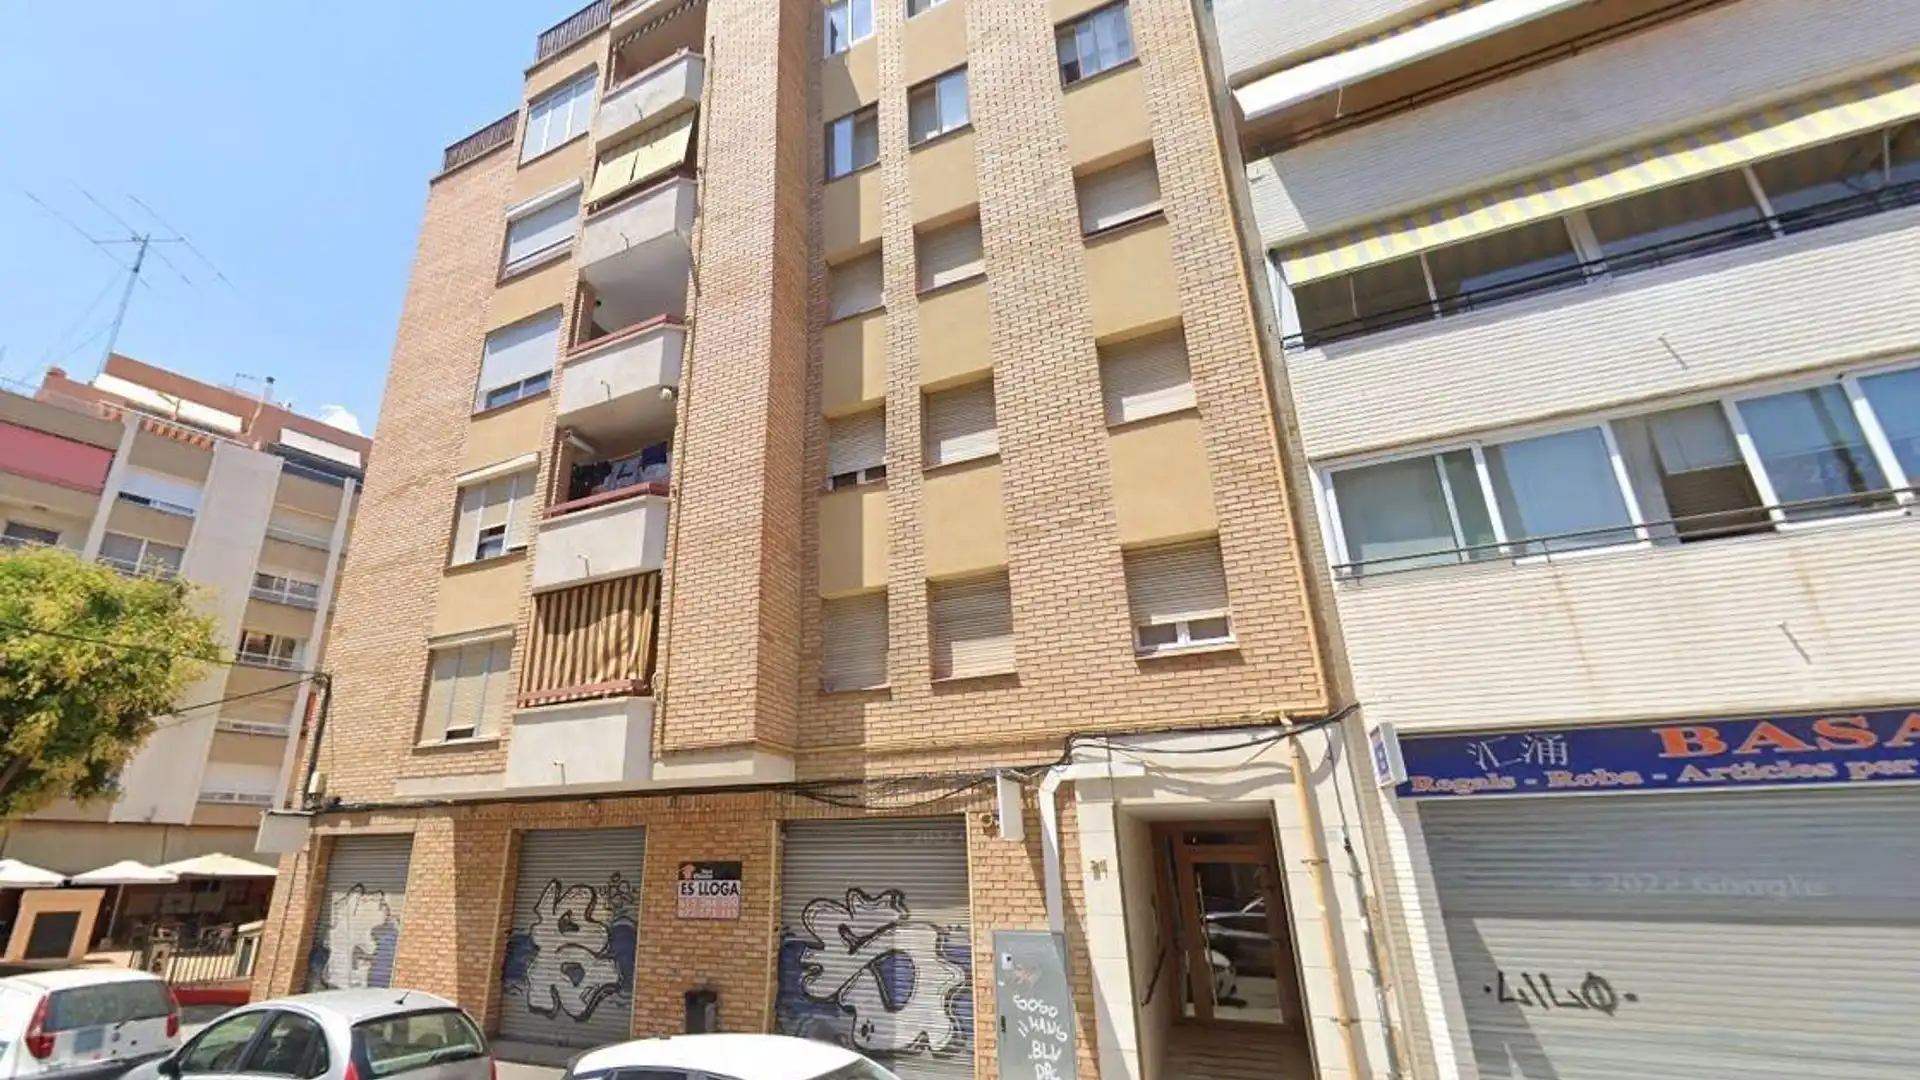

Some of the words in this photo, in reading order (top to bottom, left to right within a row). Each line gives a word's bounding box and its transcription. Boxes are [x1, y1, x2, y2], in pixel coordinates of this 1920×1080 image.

[1676, 760, 1838, 783] Articles
[681, 882, 695, 896] ES
[698, 882, 739, 896] LLOGA
